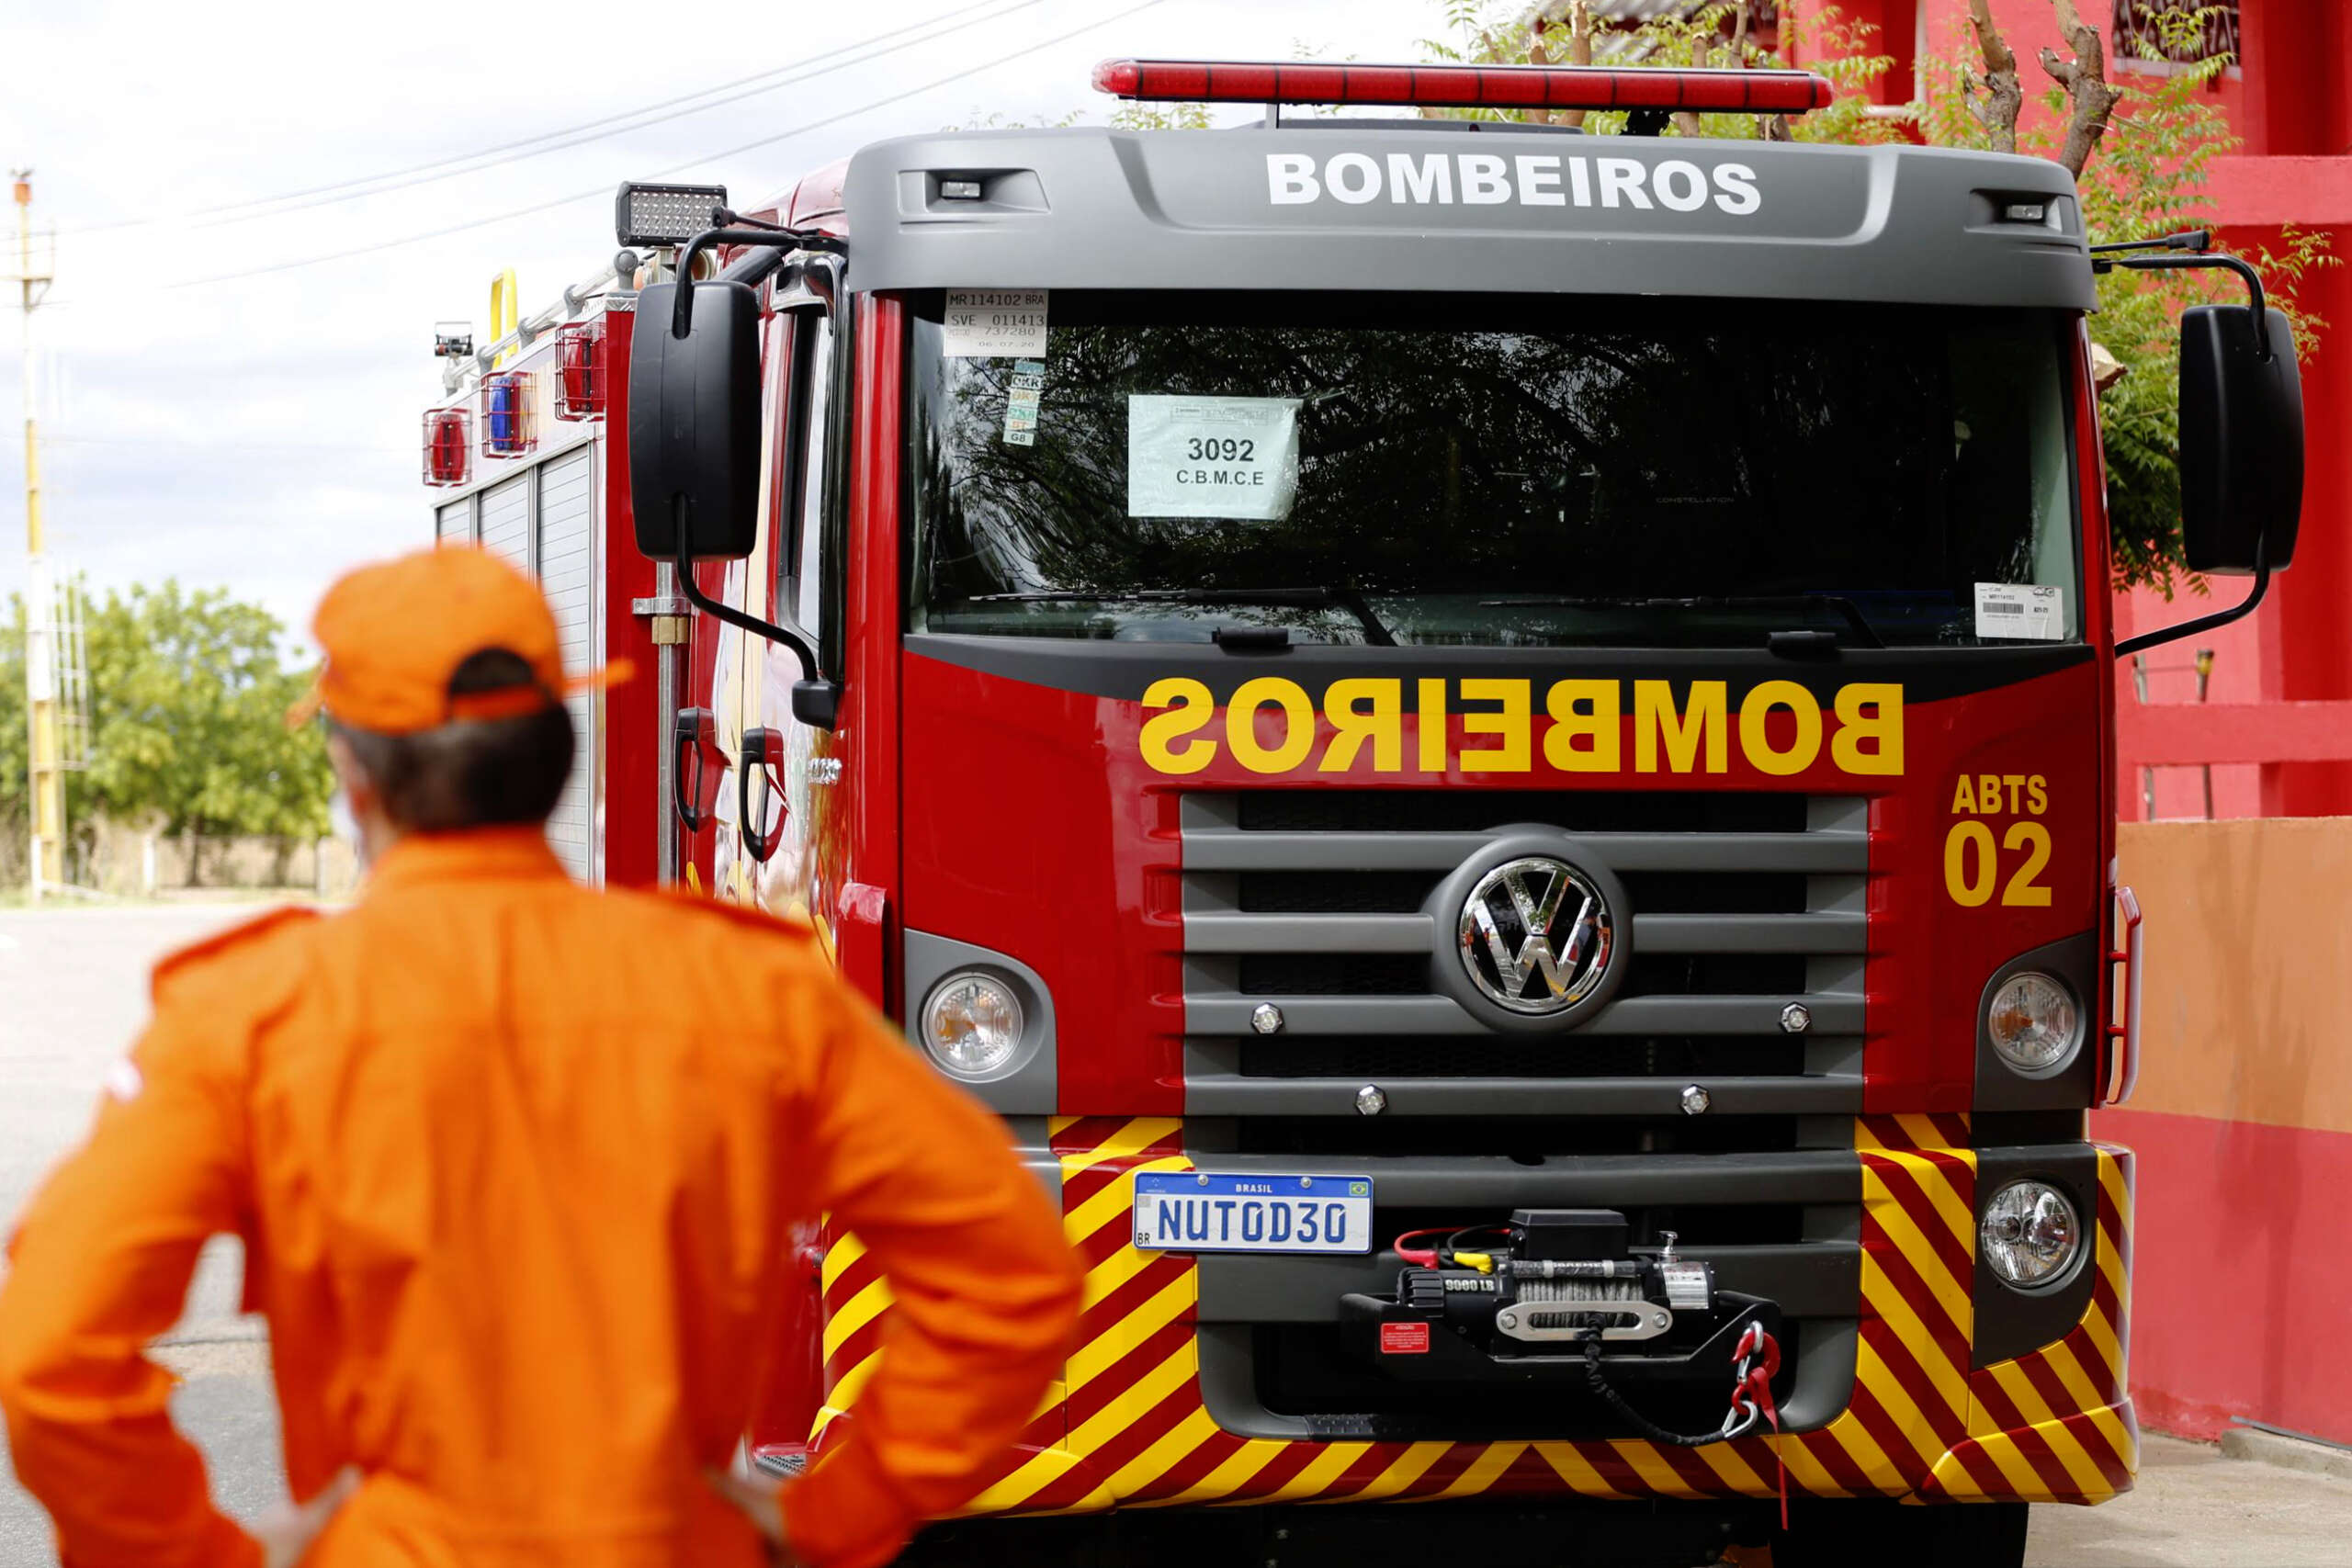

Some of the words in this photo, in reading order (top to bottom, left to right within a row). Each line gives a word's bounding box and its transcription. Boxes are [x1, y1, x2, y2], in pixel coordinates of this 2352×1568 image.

[1266, 152, 1761, 215] BOMBEIROS
[950, 294, 1021, 306] MR114102
[1024, 294, 1045, 305] BRA
[952, 314, 977, 326] SVE
[992, 314, 1045, 326] 011413
[985, 327, 1035, 336] 737280
[1011, 433, 1026, 442] G8
[1188, 438, 1254, 462] 3092
[1176, 470, 1264, 485] C.B.M.C.E
[1951, 774, 2048, 815] ABTS
[1944, 820, 2052, 907] 02
[1235, 1184, 1272, 1193] BRASIL
[1137, 1233, 1150, 1245] BR
[1480, 1279, 1495, 1292] LB
